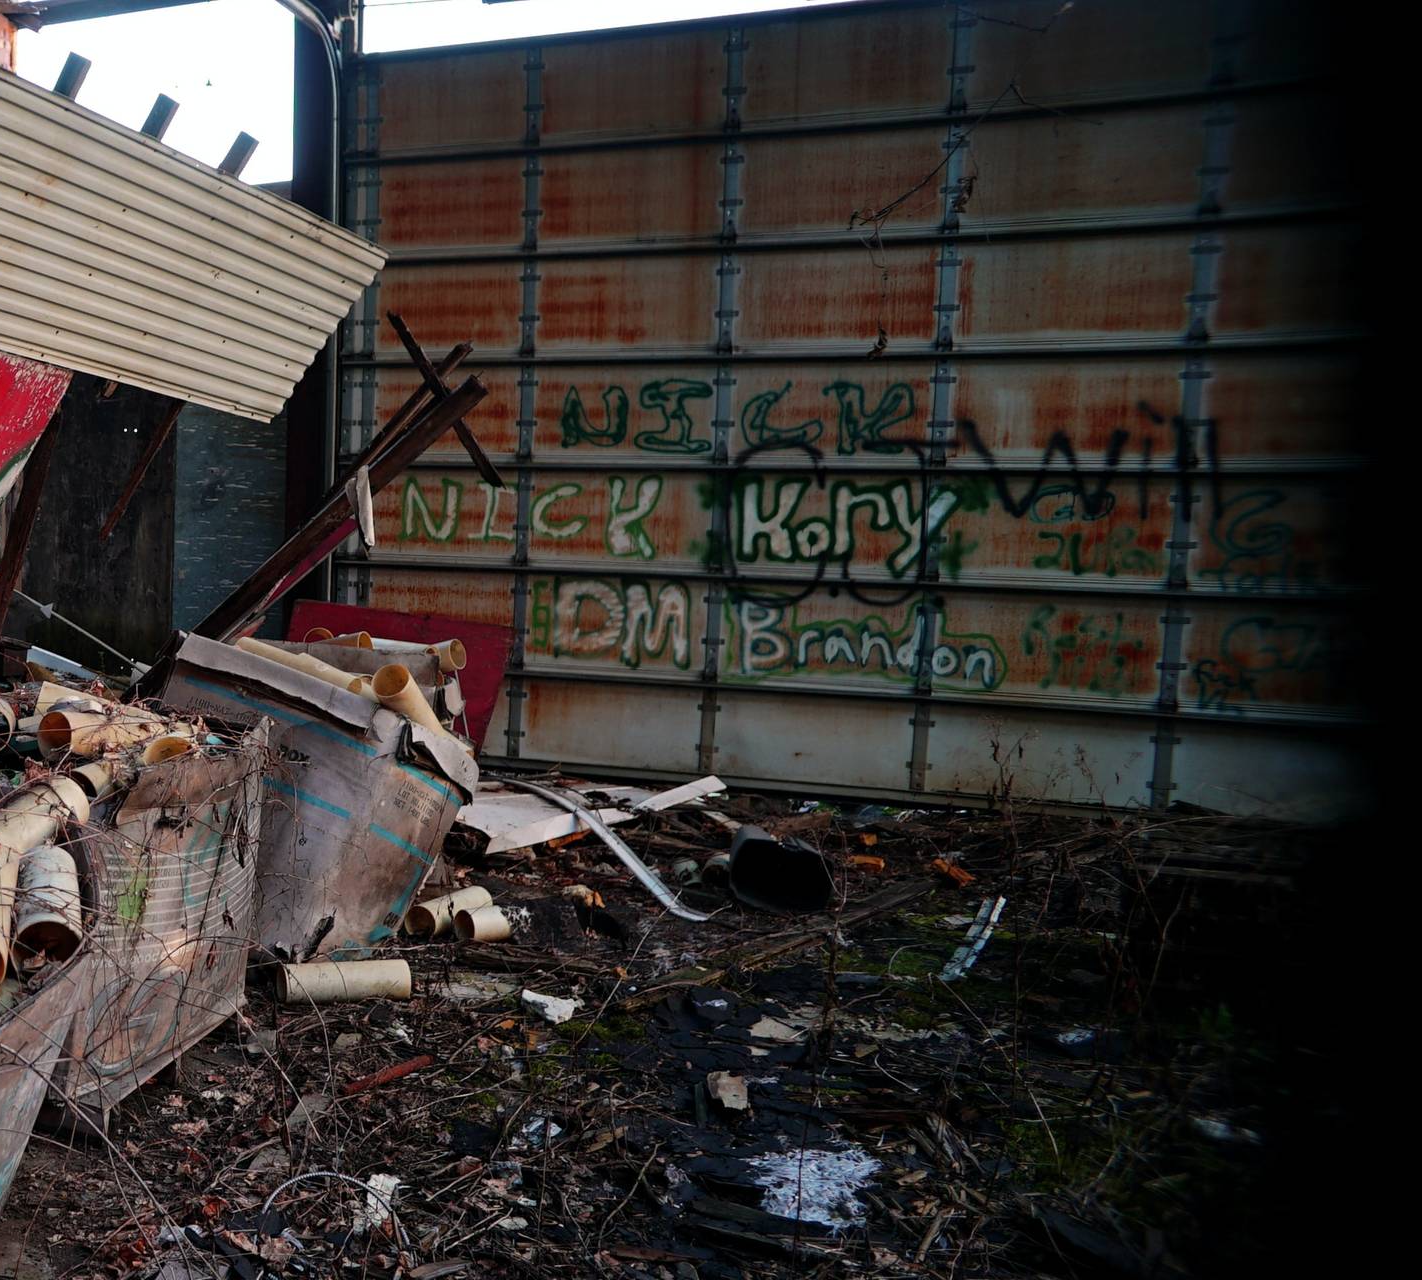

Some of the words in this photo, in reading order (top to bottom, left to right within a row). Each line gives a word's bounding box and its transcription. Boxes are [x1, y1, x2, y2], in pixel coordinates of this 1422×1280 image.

[561, 379, 915, 455] NICK
[401, 474, 662, 560] NICK
[735, 475, 962, 578] Kory
[738, 599, 997, 689] Brandon
